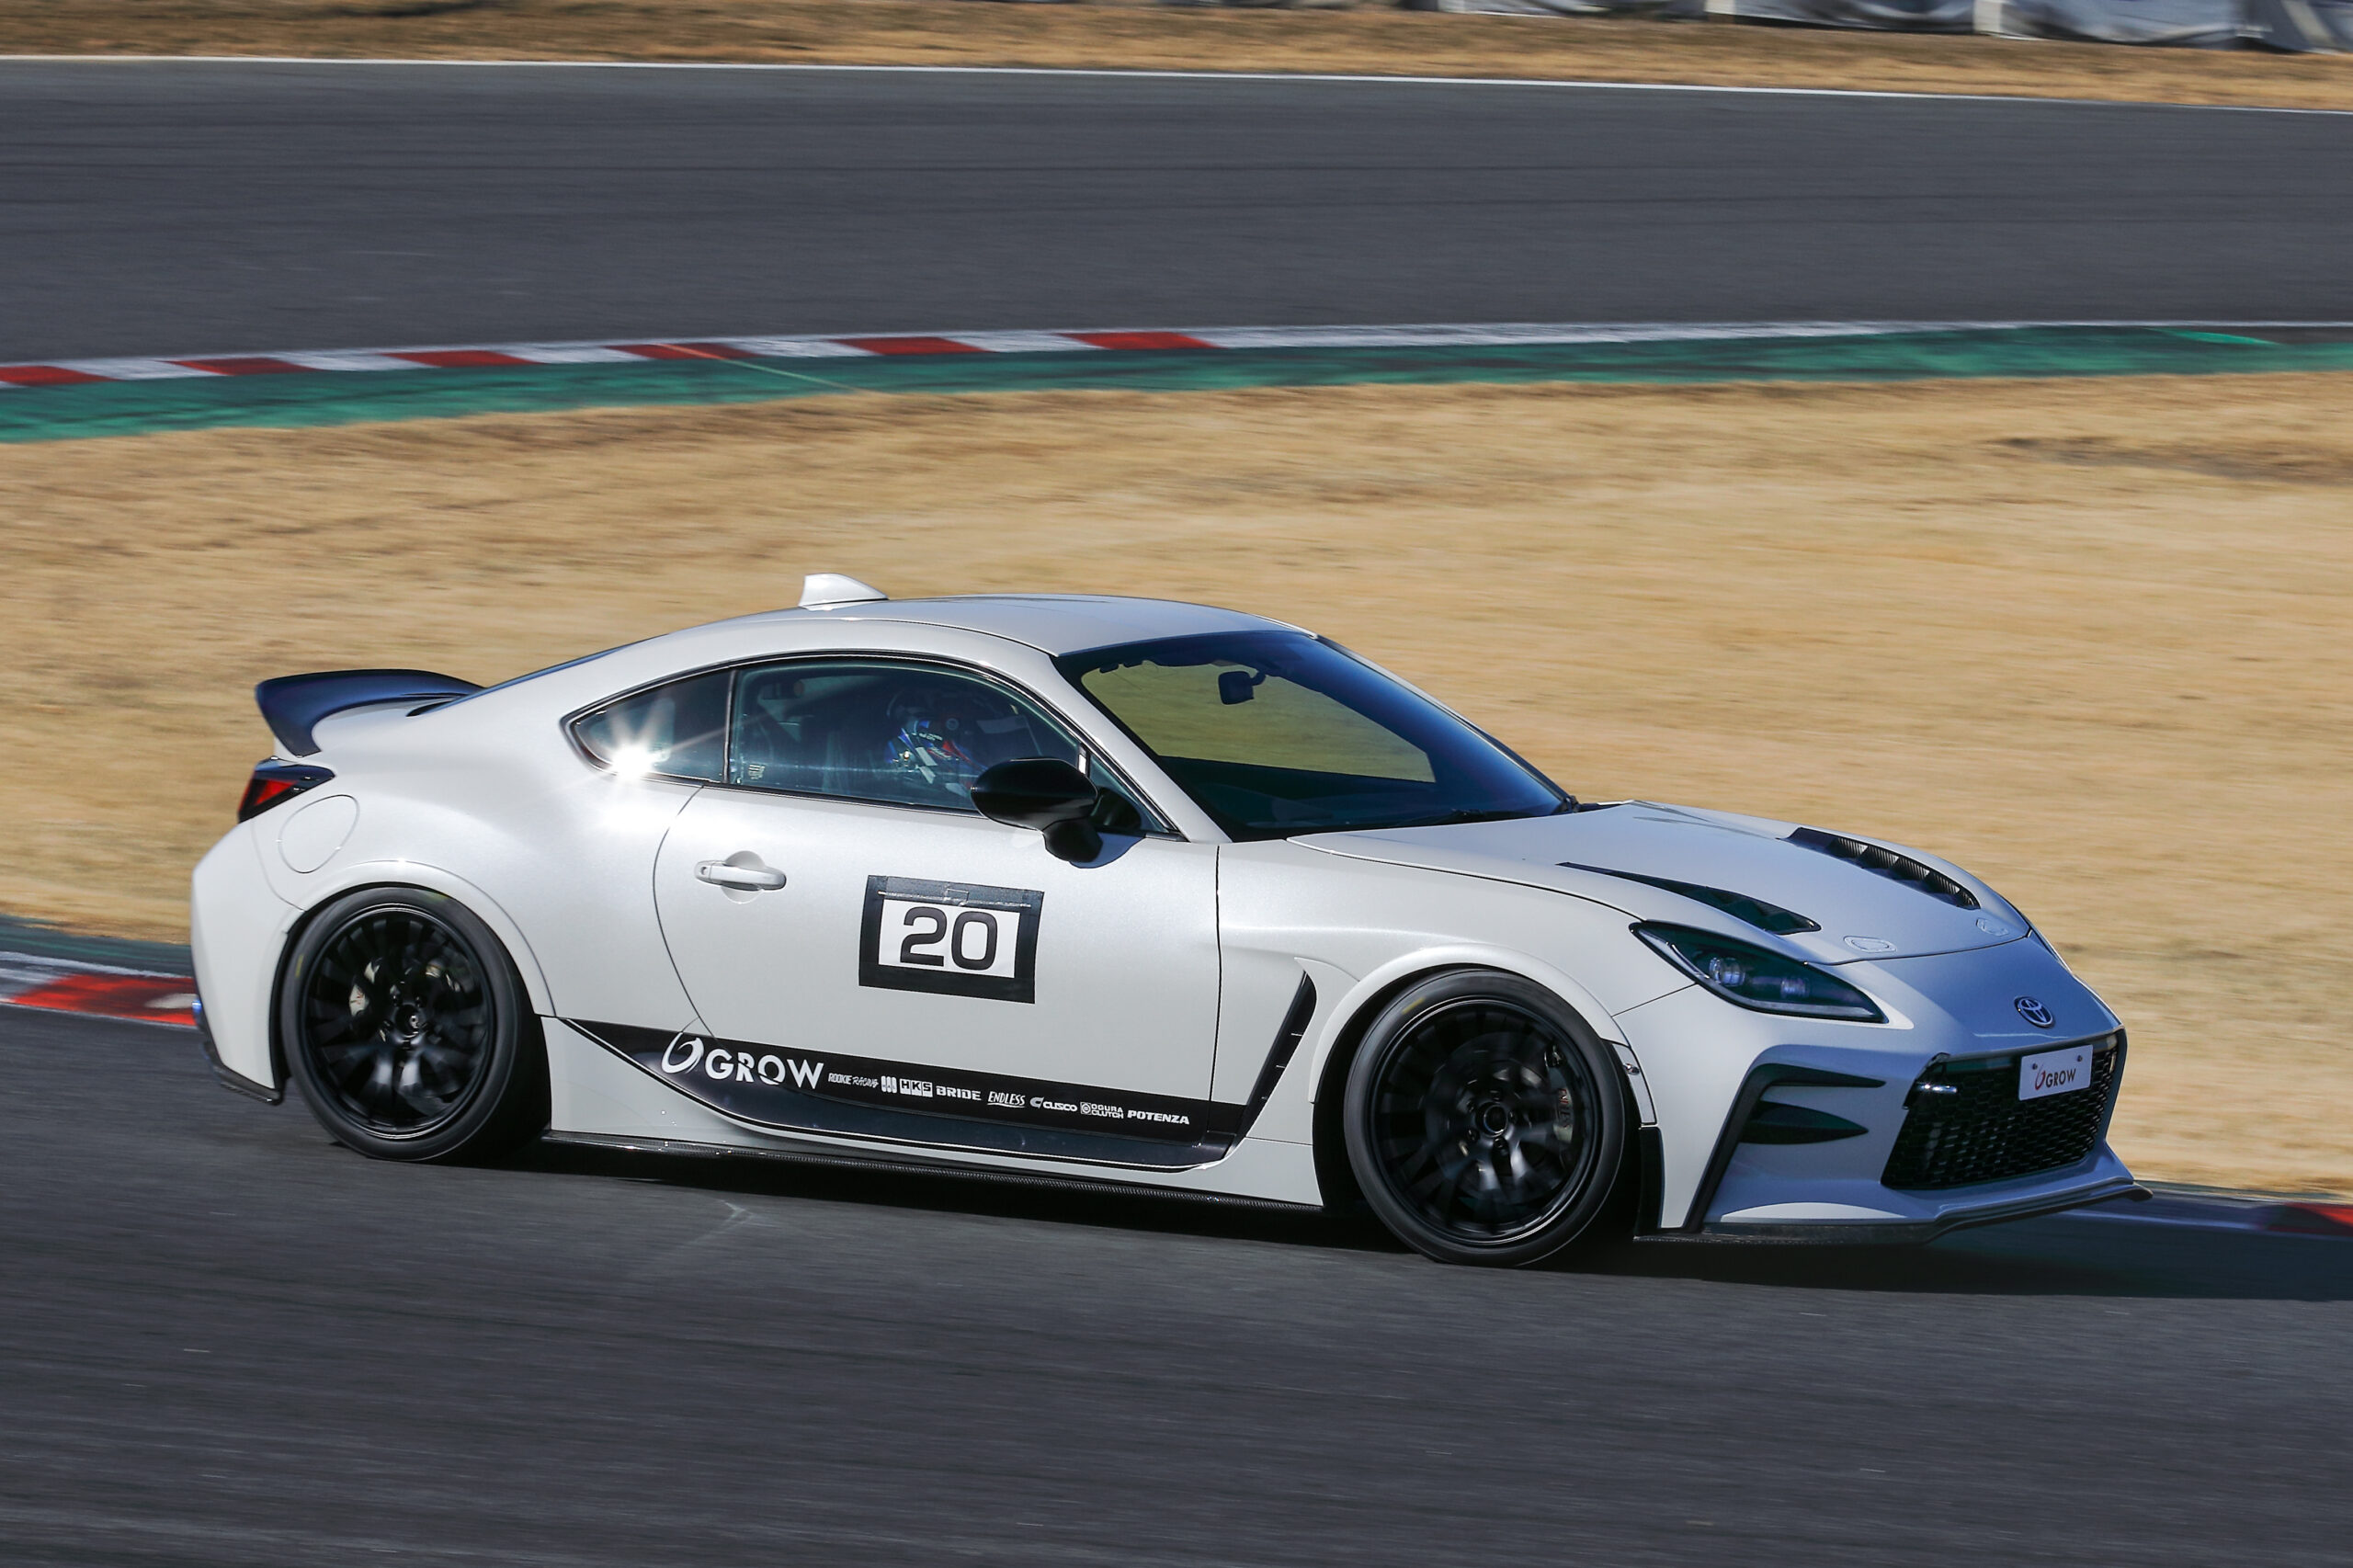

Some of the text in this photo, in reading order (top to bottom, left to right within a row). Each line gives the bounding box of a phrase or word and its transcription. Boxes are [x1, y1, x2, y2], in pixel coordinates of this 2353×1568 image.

[900, 906, 998, 971] 20
[704, 1049, 824, 1089] GROW
[828, 1073, 852, 1085] ROOKIE
[2045, 1068, 2076, 1088] GROW
[901, 1080, 932, 1093] HKS
[936, 1085, 982, 1101] BRIDE
[987, 1091, 1026, 1107] ENDLESS
[1091, 1104, 1123, 1113] OGURA
[1091, 1109, 1124, 1119] CLUTCH
[1128, 1109, 1189, 1125] POTENZA
